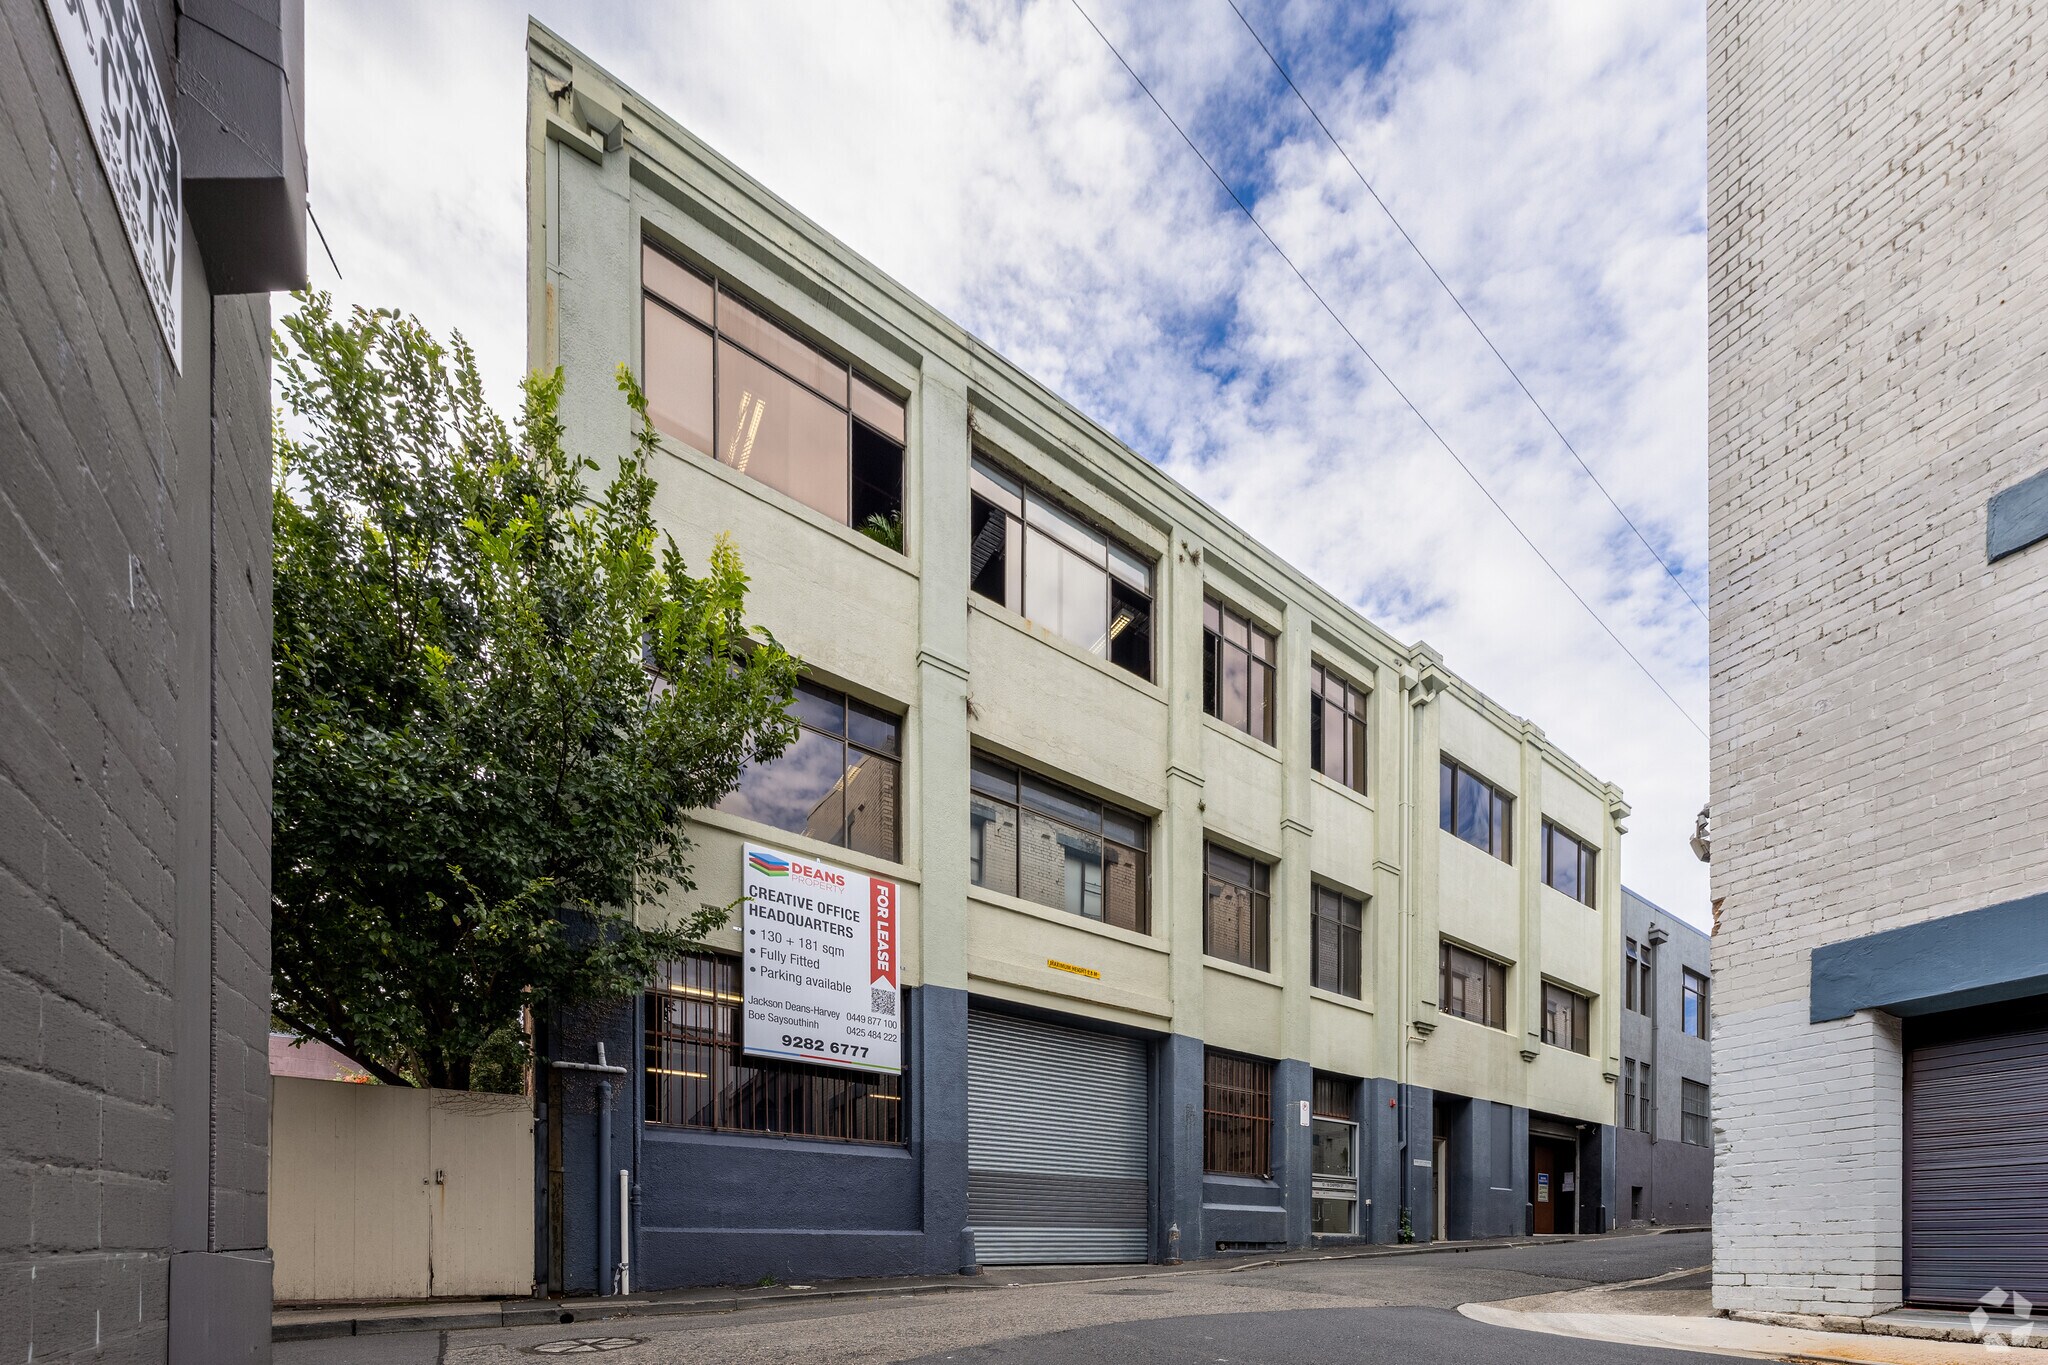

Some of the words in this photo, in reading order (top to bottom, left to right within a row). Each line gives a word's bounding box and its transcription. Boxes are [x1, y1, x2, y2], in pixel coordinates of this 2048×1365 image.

[100, 38, 176, 295] CCTV
[791, 862, 845, 886] DEANS
[791, 874, 845, 894] PROPERTY
[749, 884, 813, 911] CREATIVE
[817, 901, 860, 923] OFFICE
[876, 884, 889, 919] FOR
[749, 903, 854, 939] HEADQUARTERS
[761, 929, 782, 944] 130
[799, 937, 818, 951] 181
[822, 944, 845, 957] sqm
[877, 920, 889, 972] LEASE
[760, 947, 787, 964] Fully
[790, 953, 820, 969] Fitted
[760, 966, 802, 986] Parking
[805, 976, 852, 993] available
[748, 995, 783, 1009] Jackson
[785, 1001, 840, 1020] Deans-Harvey
[748, 1010, 766, 1020] Boe
[768, 1013, 819, 1029] Saysouthinh
[846, 1012, 866, 1024] 0449
[867, 1018, 882, 1027] 877
[884, 1019, 898, 1029] 100
[781, 1034, 824, 1051] 9282
[829, 1042, 869, 1058] 6777
[846, 1026, 866, 1037] 0425
[867, 1031, 882, 1040] 484
[883, 1033, 898, 1043] 222
